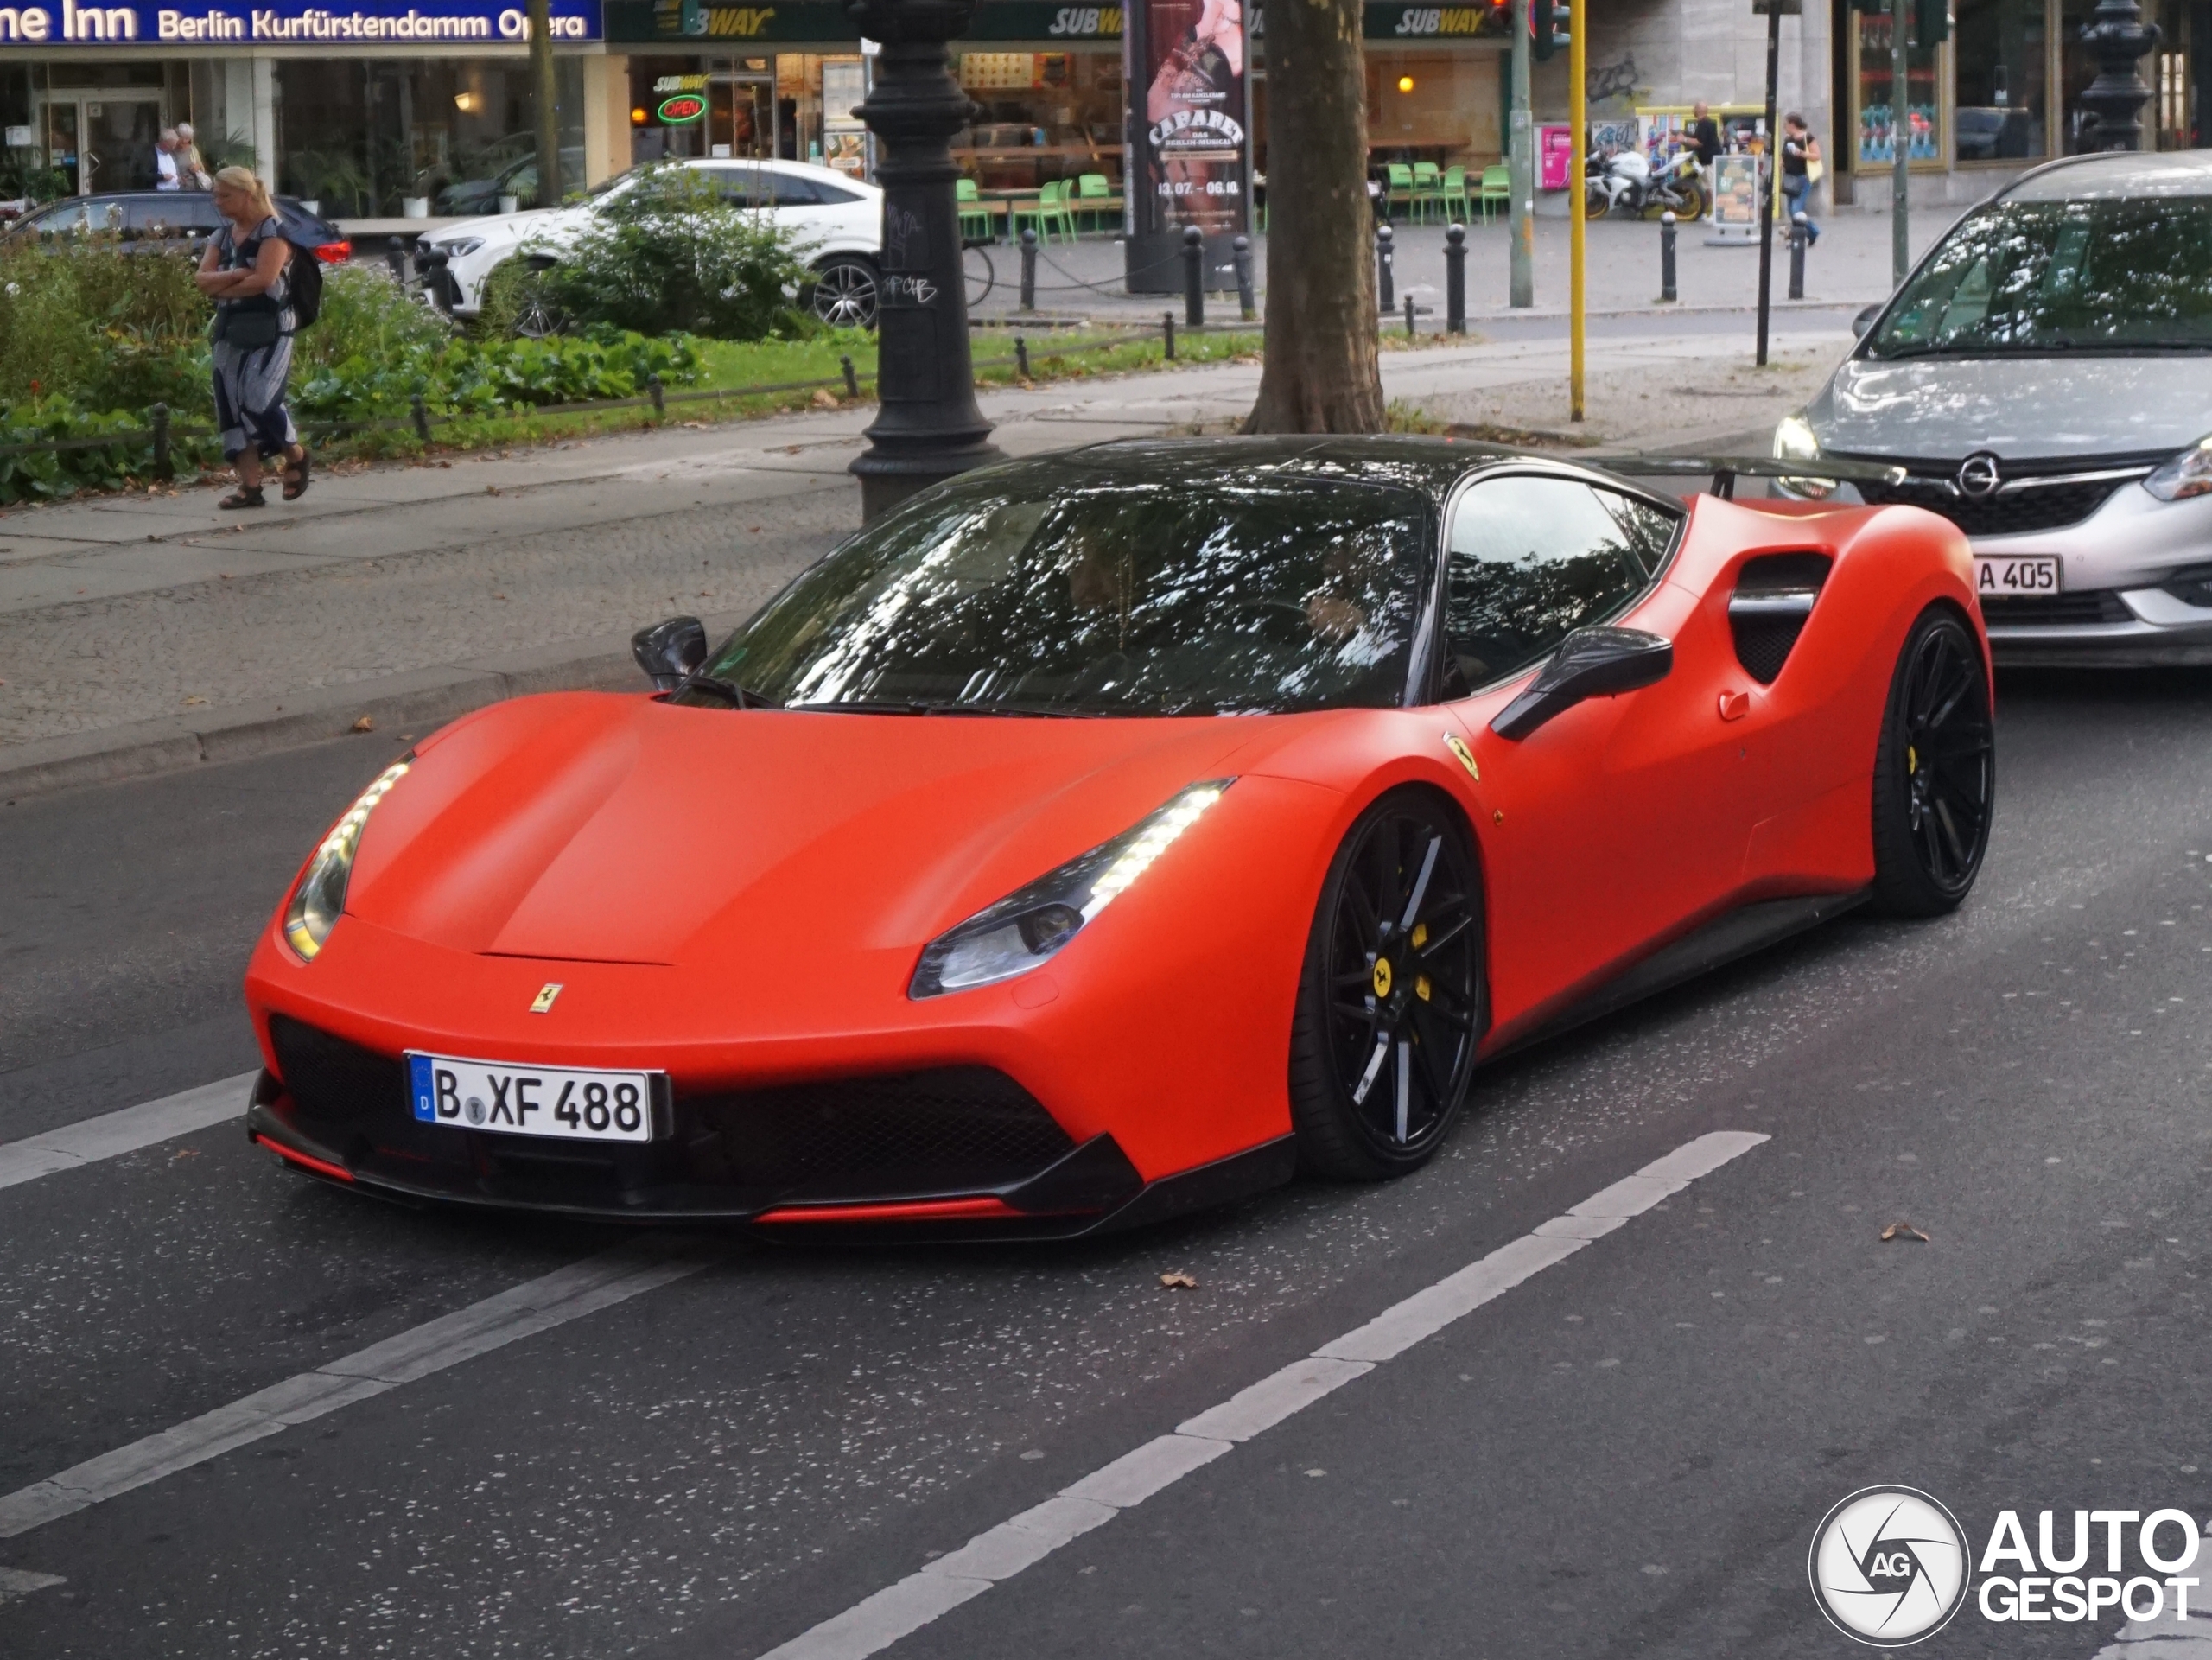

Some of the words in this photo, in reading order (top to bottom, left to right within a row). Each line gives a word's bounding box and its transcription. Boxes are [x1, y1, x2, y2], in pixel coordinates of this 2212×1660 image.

[63, 0, 133, 38] Inn
[158, 10, 241, 38] Berlin
[251, 10, 486, 37] Kurfürstendamm
[694, 7, 775, 35] BWAY
[1395, 9, 1484, 34] SUBWAY
[653, 73, 710, 92] SUBWAY
[664, 99, 701, 117] OPEN
[1149, 109, 1243, 145] CABARET
[1979, 563, 1995, 589] A
[2003, 562, 2053, 589] 405
[420, 1095, 429, 1110] D
[435, 1068, 461, 1119] B
[486, 1073, 543, 1127] XF
[554, 1080, 641, 1133] 488
